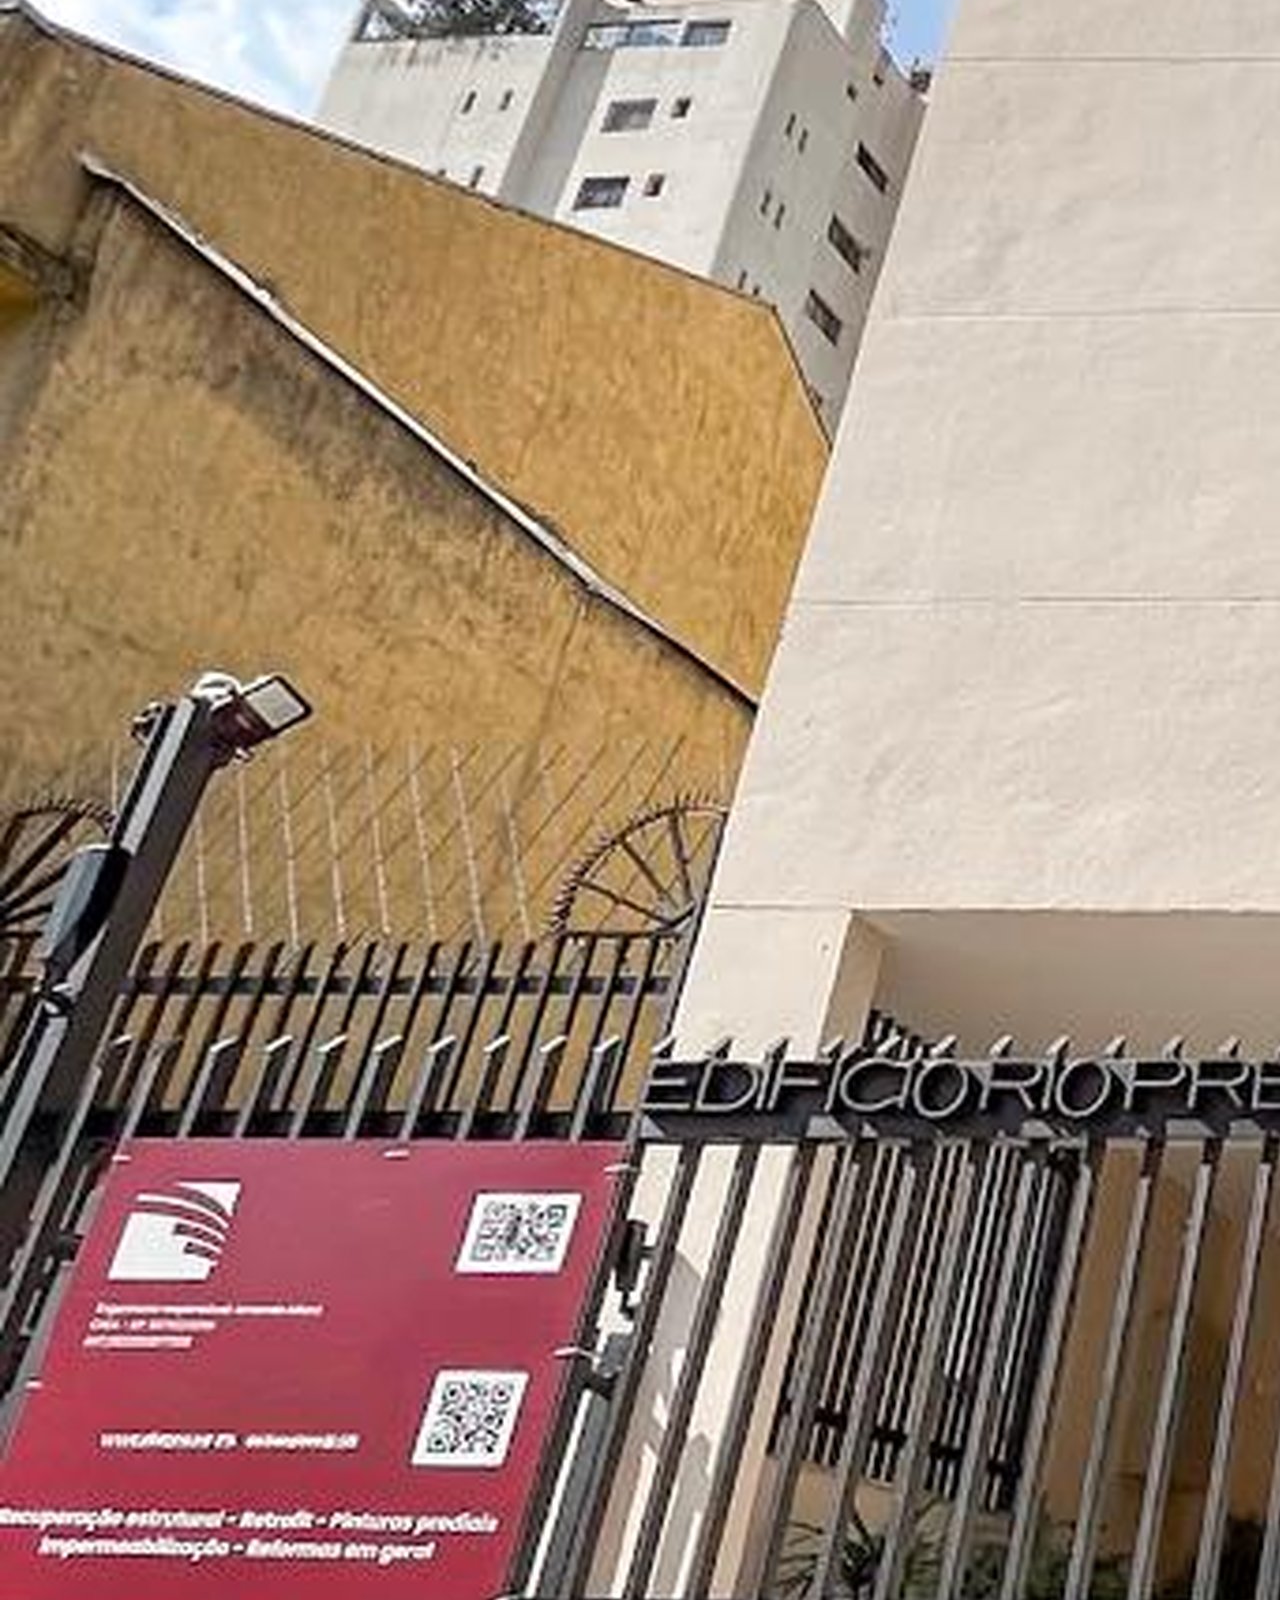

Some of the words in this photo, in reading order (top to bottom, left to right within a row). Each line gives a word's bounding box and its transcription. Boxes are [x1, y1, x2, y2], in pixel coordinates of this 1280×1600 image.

[979, 1057, 1112, 1118] RIO
[125, 1509, 226, 1529] estrutural
[240, 1510, 315, 1529] Retrofit
[413, 1512, 499, 1536] prediais
[247, 1539, 343, 1559] Reformas
[344, 1543, 377, 1559] em
[378, 1541, 436, 1566] geral
